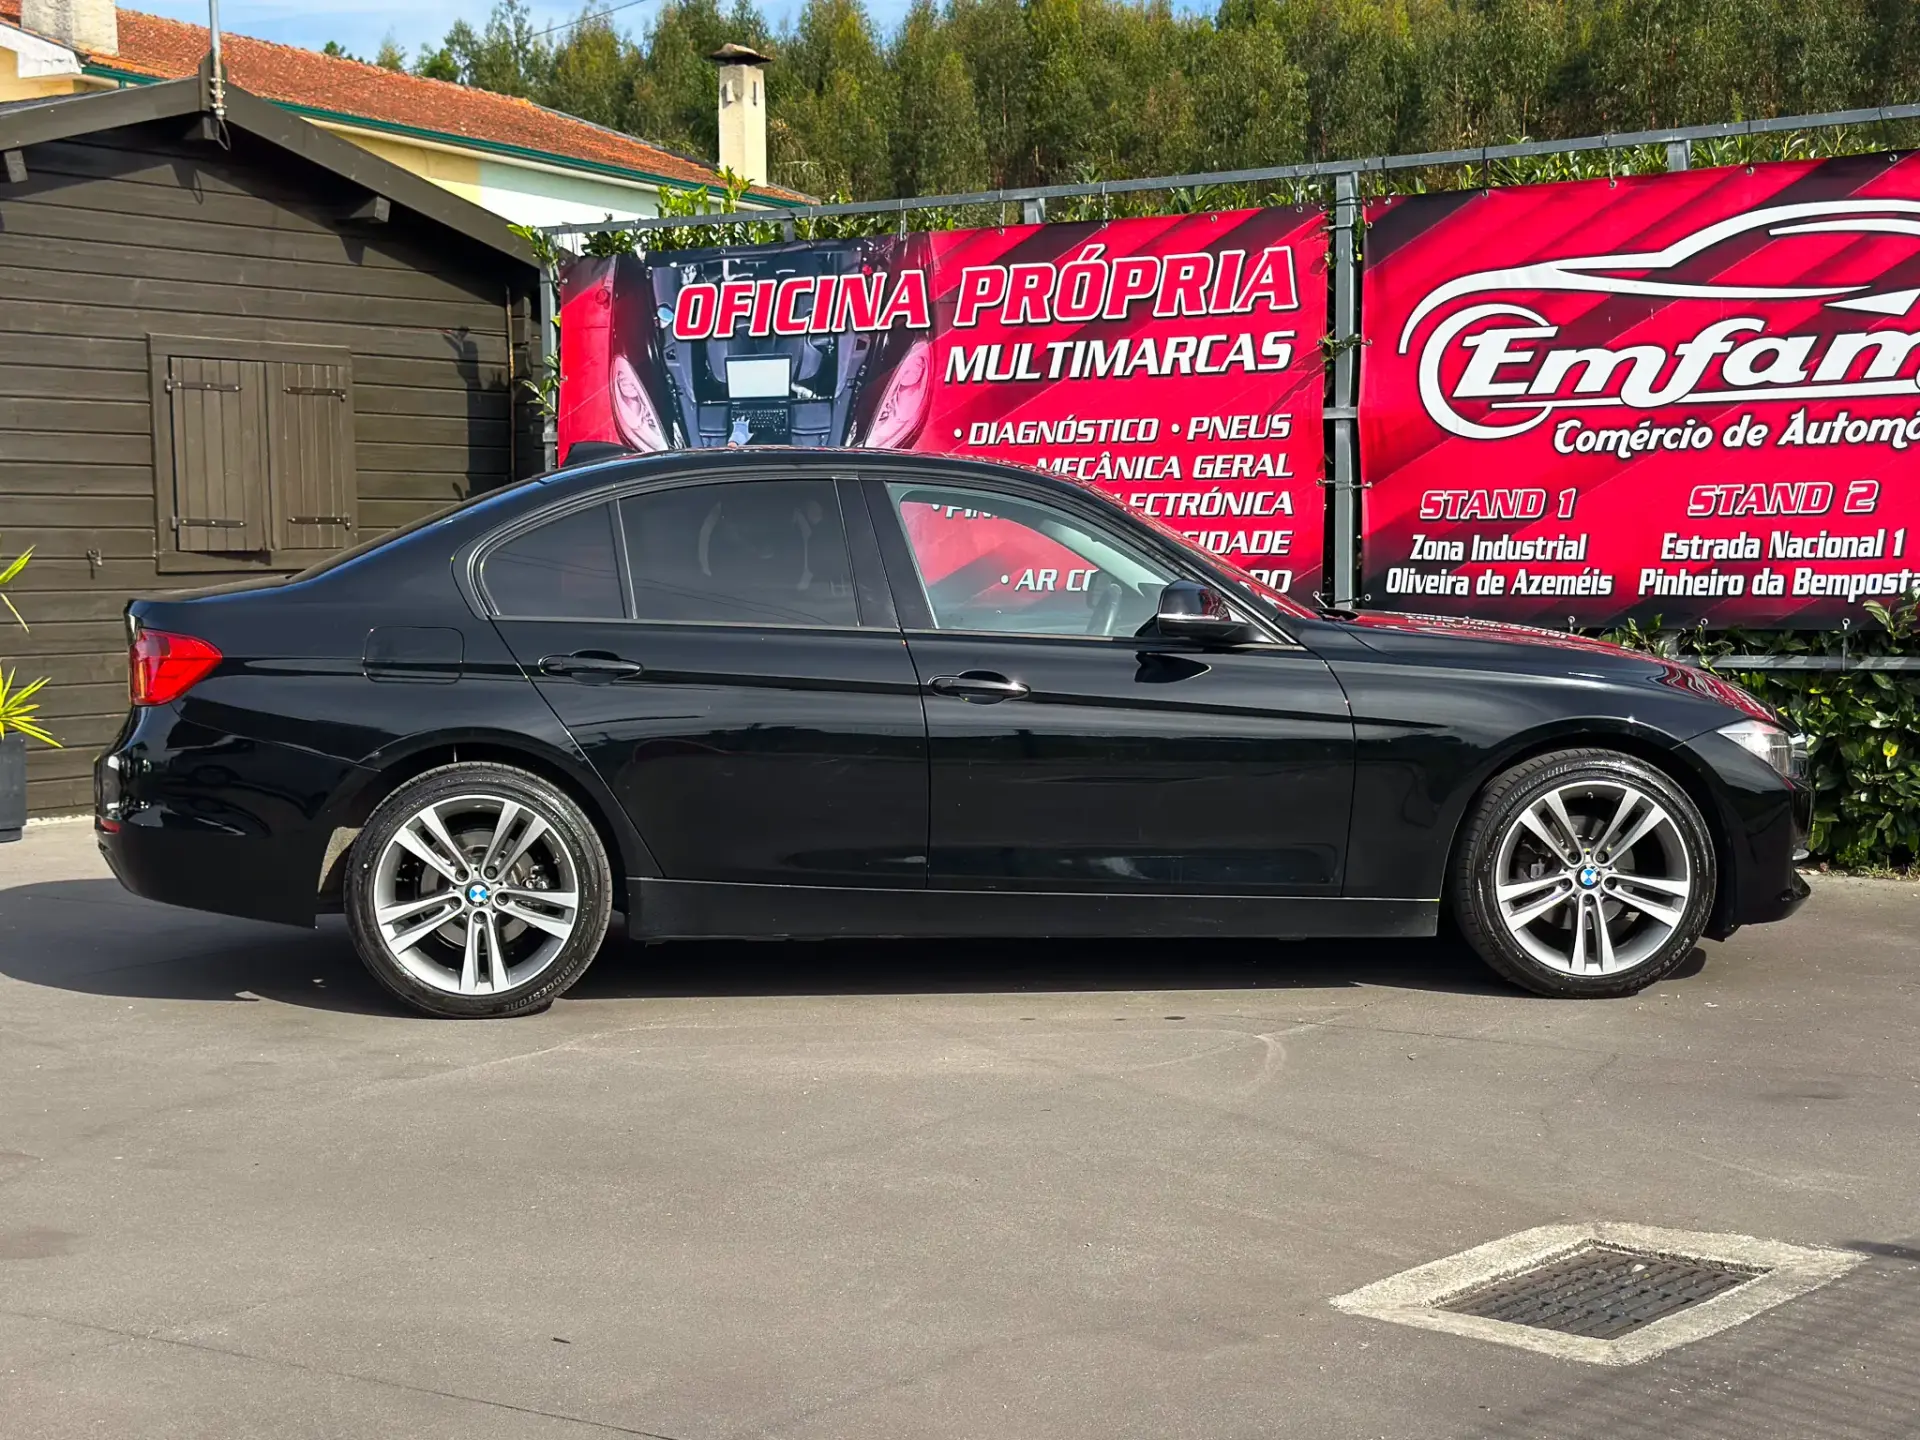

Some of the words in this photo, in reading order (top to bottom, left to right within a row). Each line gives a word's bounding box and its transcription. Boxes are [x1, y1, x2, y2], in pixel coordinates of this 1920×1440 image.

[673, 270, 930, 340] OFICINA
[953, 244, 1299, 327] PRÓPRIA
[944, 330, 1295, 382] MULTIMARCAS
[967, 416, 1159, 445] DIAGNÓSTICO
[1187, 413, 1292, 440] PNEUS
[1554, 418, 1713, 458] Comércio
[1722, 414, 1769, 447] de
[1192, 453, 1293, 479] GERAL
[1420, 488, 1546, 520] STAND
[1557, 488, 1576, 518] 1
[1687, 481, 1833, 516] STAND
[1844, 480, 1879, 513] 2
[1410, 534, 1464, 561] Zona
[1471, 533, 1587, 561] Industrial
[1661, 531, 1761, 560] Estrada
[1768, 528, 1885, 559] Nacional
[1893, 528, 1905, 557] 1
[1015, 569, 1057, 591] AR
[1386, 568, 1469, 595] Oliveira
[1476, 569, 1504, 595] de
[1510, 567, 1612, 595] Azeméis
[1638, 568, 1744, 596] Pinheiro
[1752, 567, 1784, 595] da
